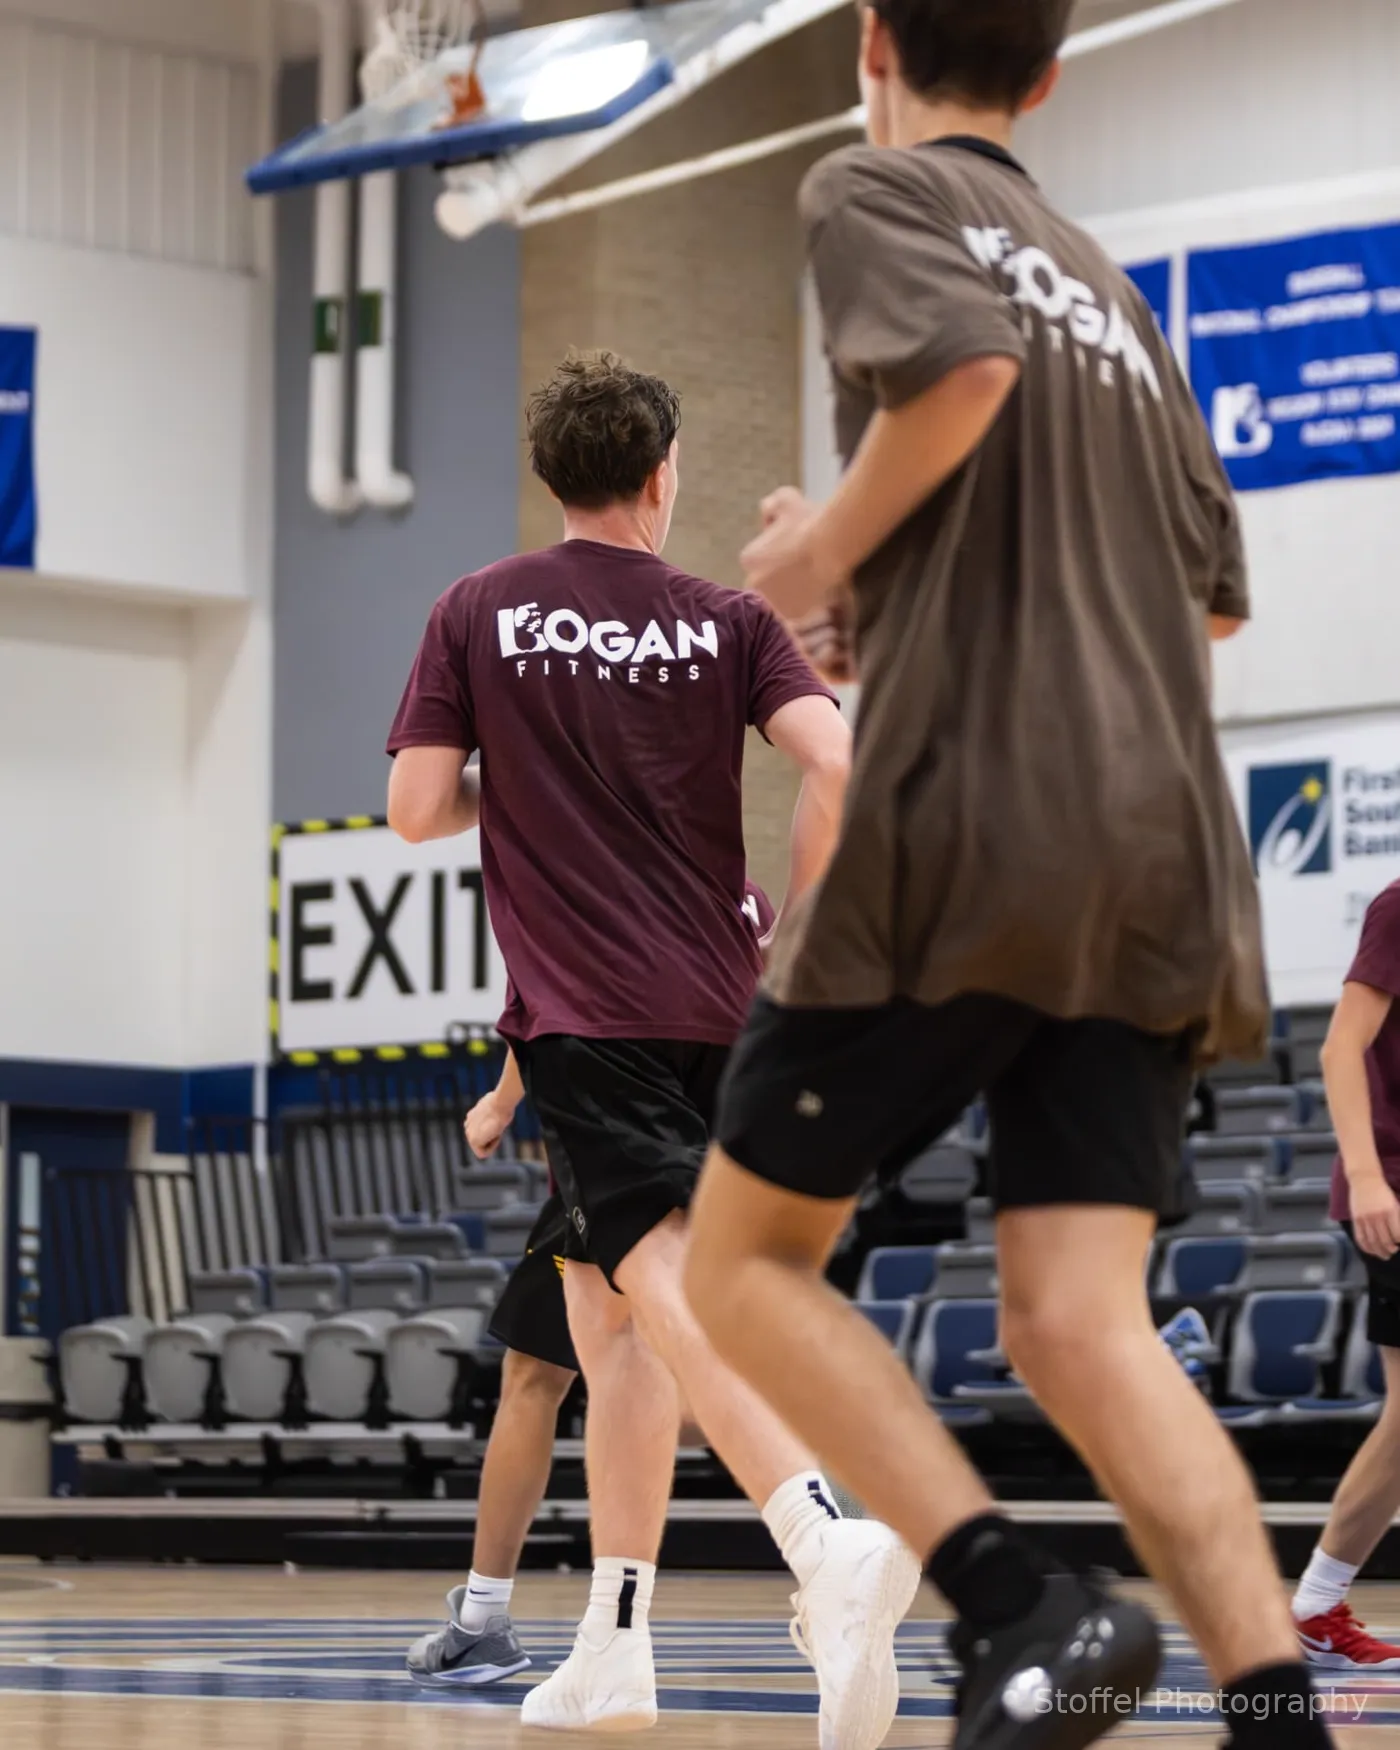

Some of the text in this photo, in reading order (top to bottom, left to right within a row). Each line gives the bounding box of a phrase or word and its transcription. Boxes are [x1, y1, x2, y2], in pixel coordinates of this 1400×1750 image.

[497, 602, 719, 663] BOGAN
[517, 659, 700, 684] FITNESS
[290, 868, 489, 1003] EXIT
